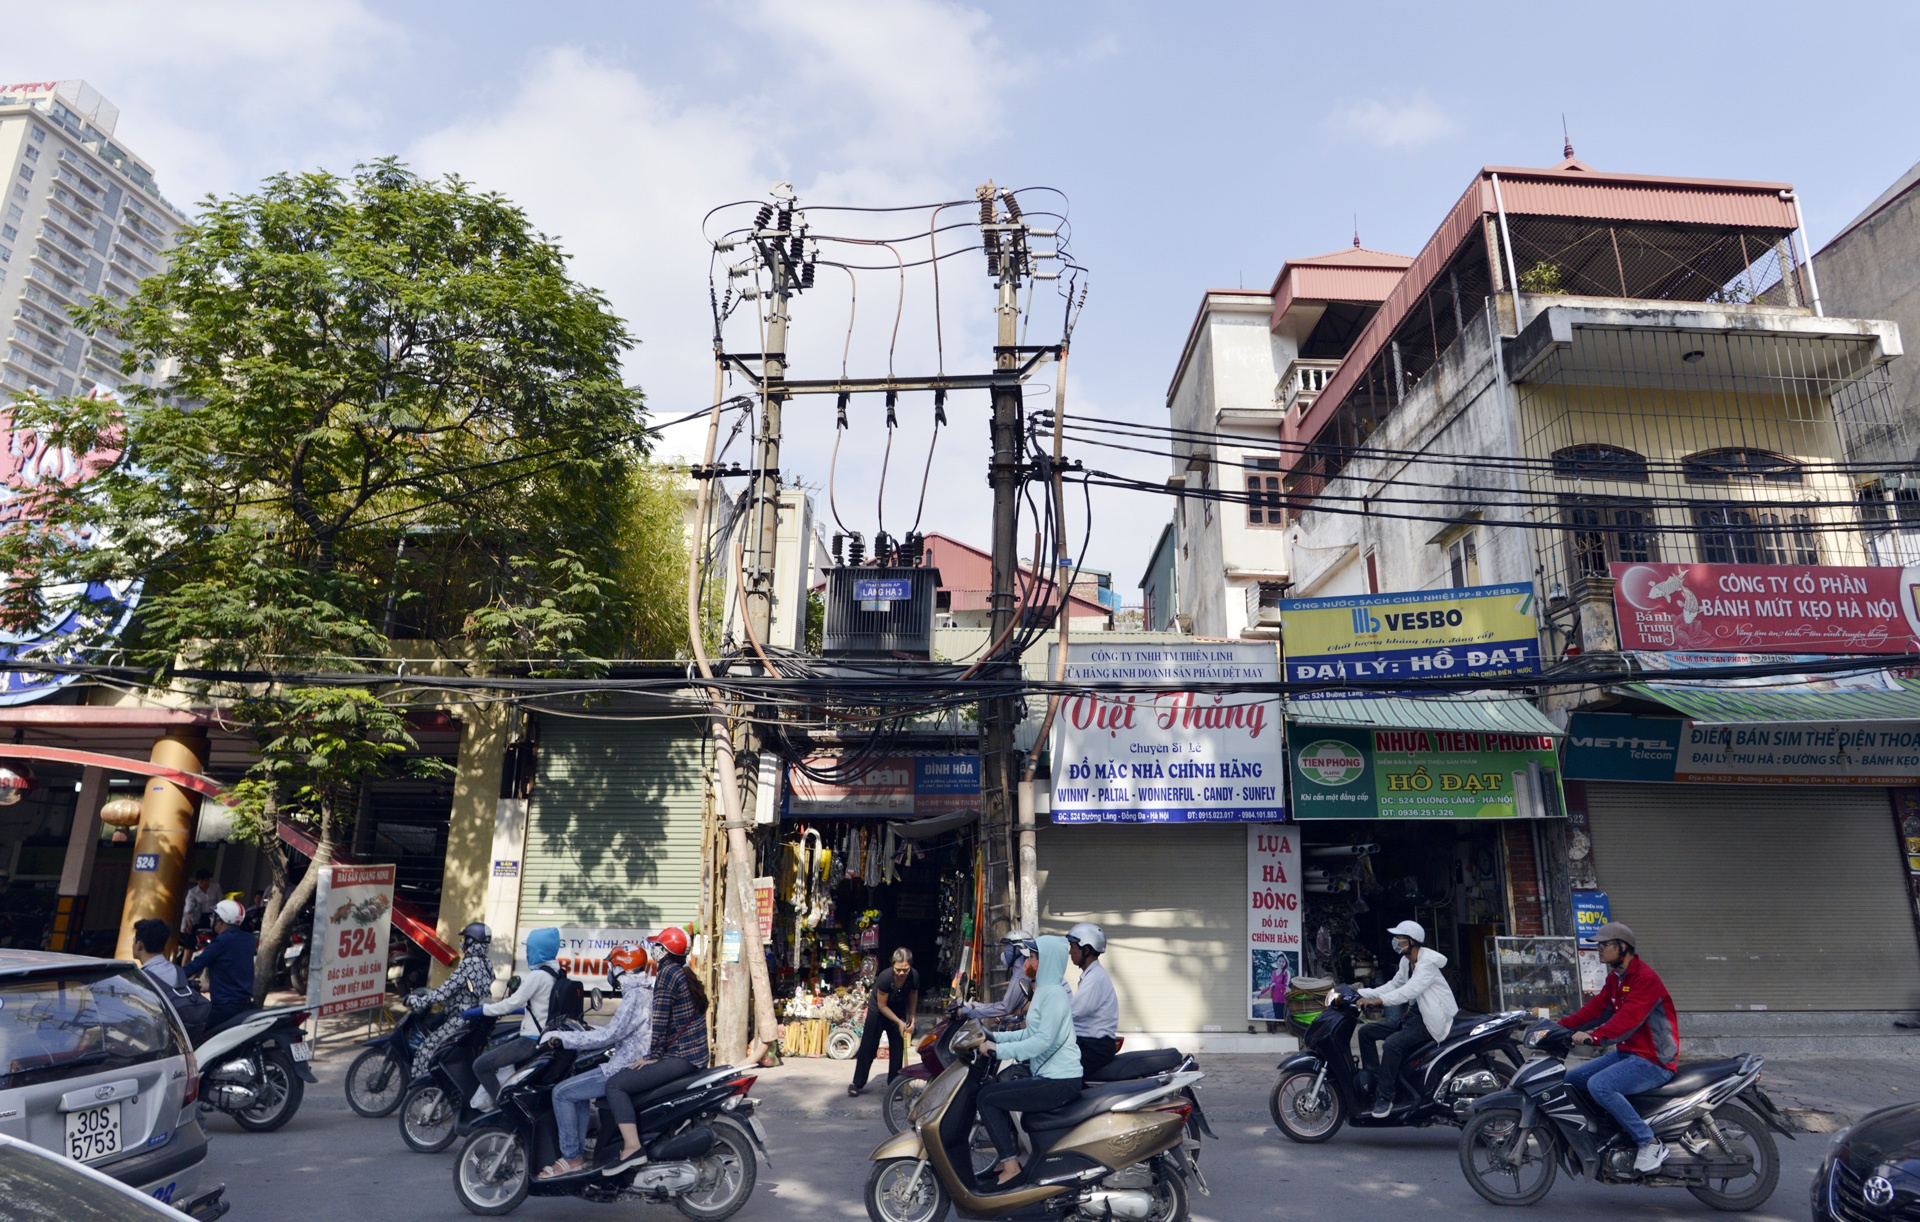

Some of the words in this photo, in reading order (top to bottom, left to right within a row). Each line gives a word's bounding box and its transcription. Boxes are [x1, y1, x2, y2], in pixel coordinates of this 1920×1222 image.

[1719, 574, 1765, 593] CÔNG
[1768, 576, 1788, 593] TY
[1793, 572, 1816, 594] CỔ
[1820, 570, 1868, 594] PHẦN
[1458, 590, 1482, 599] PP-R
[1485, 587, 1520, 597] VESBO
[1703, 598, 1751, 617] BÁNH
[1755, 599, 1793, 618] MỨT
[1799, 600, 1834, 620] KẸO
[1837, 597, 1863, 618] HÀ
[1866, 598, 1898, 621] NỘI
[1384, 609, 1463, 632] VESBO
[1636, 611, 1672, 622] Bánh
[1640, 633, 1663, 643] Thu
[1092, 649, 1118, 662] CÔNG
[1120, 652, 1133, 662] TY
[1135, 651, 1161, 662] TNHH
[1163, 652, 1180, 662] TM
[1210, 651, 1233, 661] LINH
[1297, 663, 1346, 680] ĐẠ
[1410, 647, 1455, 671] HỒ
[1467, 647, 1529, 667] ĐẠT
[1083, 667, 1110, 679] HÀNG
[1112, 668, 1136, 678] KINH
[1138, 668, 1171, 678] DOANH
[1173, 665, 1192, 678] SẢN
[1193, 663, 1221, 679] PHẨM
[1222, 667, 1241, 681] DỆT
[1243, 668, 1264, 678] MAY
[1061, 690, 1137, 738] Việt
[1153, 691, 1268, 738] Thắng
[1375, 730, 1432, 757] NHỰA
[1736, 727, 1770, 746] BÁN
[1773, 731, 1802, 746] SIM
[1806, 727, 1836, 746] THẺ
[1839, 729, 1877, 751] ĐIỆN
[1129, 742, 1169, 755] Chuyên
[1630, 750, 1672, 760] Telecom
[1302, 758, 1325, 767] TIEN
[1326, 758, 1361, 767] PHONG
[1692, 753, 1713, 765] ĐẠI
[1733, 754, 1755, 763] THU
[1783, 753, 1826, 765] ĐƯỜNG
[1862, 753, 1894, 766] BÁNH
[1896, 755, 1920, 768] KẸO
[924, 762, 949, 775] ĐÌNH
[952, 761, 974, 775] HÒA
[1069, 757, 1091, 780] ĐỒ
[1095, 759, 1127, 783] MẶC
[1132, 759, 1164, 779] NHÀ
[1168, 759, 1218, 779] CHÍNH
[1220, 759, 1262, 778] HÃNG
[1387, 765, 1433, 791] HỒ
[1440, 773, 1503, 795] ĐẠT
[1057, 788, 1090, 802] WINNY
[1098, 787, 1130, 802] PALTAL
[1138, 787, 1195, 802] WONNERFUL
[1203, 787, 1233, 801] CANDY
[1242, 786, 1276, 801] SUNFLY
[1300, 793, 1312, 801] Khi
[1451, 795, 1475, 804] LÁNG
[1482, 795, 1495, 804] HÀ
[1497, 794, 1513, 805] NỘI
[1070, 812, 1081, 821] 524
[1082, 811, 1102, 823] Đường
[1102, 811, 1117, 822] Láng
[1138, 812, 1147, 821] Đa
[1150, 811, 1159, 820] Hà
[1159, 811, 1170, 822] Nội
[1187, 811, 1198, 819] ĐT:
[1397, 809, 1454, 817] 0936.251.326
[1567, 814, 1585, 824] 522
[1257, 834, 1292, 857] LỤA
[136, 856, 155, 869] 524
[375, 870, 389, 881] MINH
[1262, 861, 1287, 883] HÀ
[1252, 887, 1298, 911] ĐÔNG
[1577, 911, 1608, 925] 50%
[338, 927, 377, 958] 524
[571, 939, 584, 948] TY
[1251, 931, 1276, 943] CHÍNH
[361, 978, 374, 991] NAM
[77, 1106, 110, 1134] 30S
[72, 1129, 116, 1160] 5753
